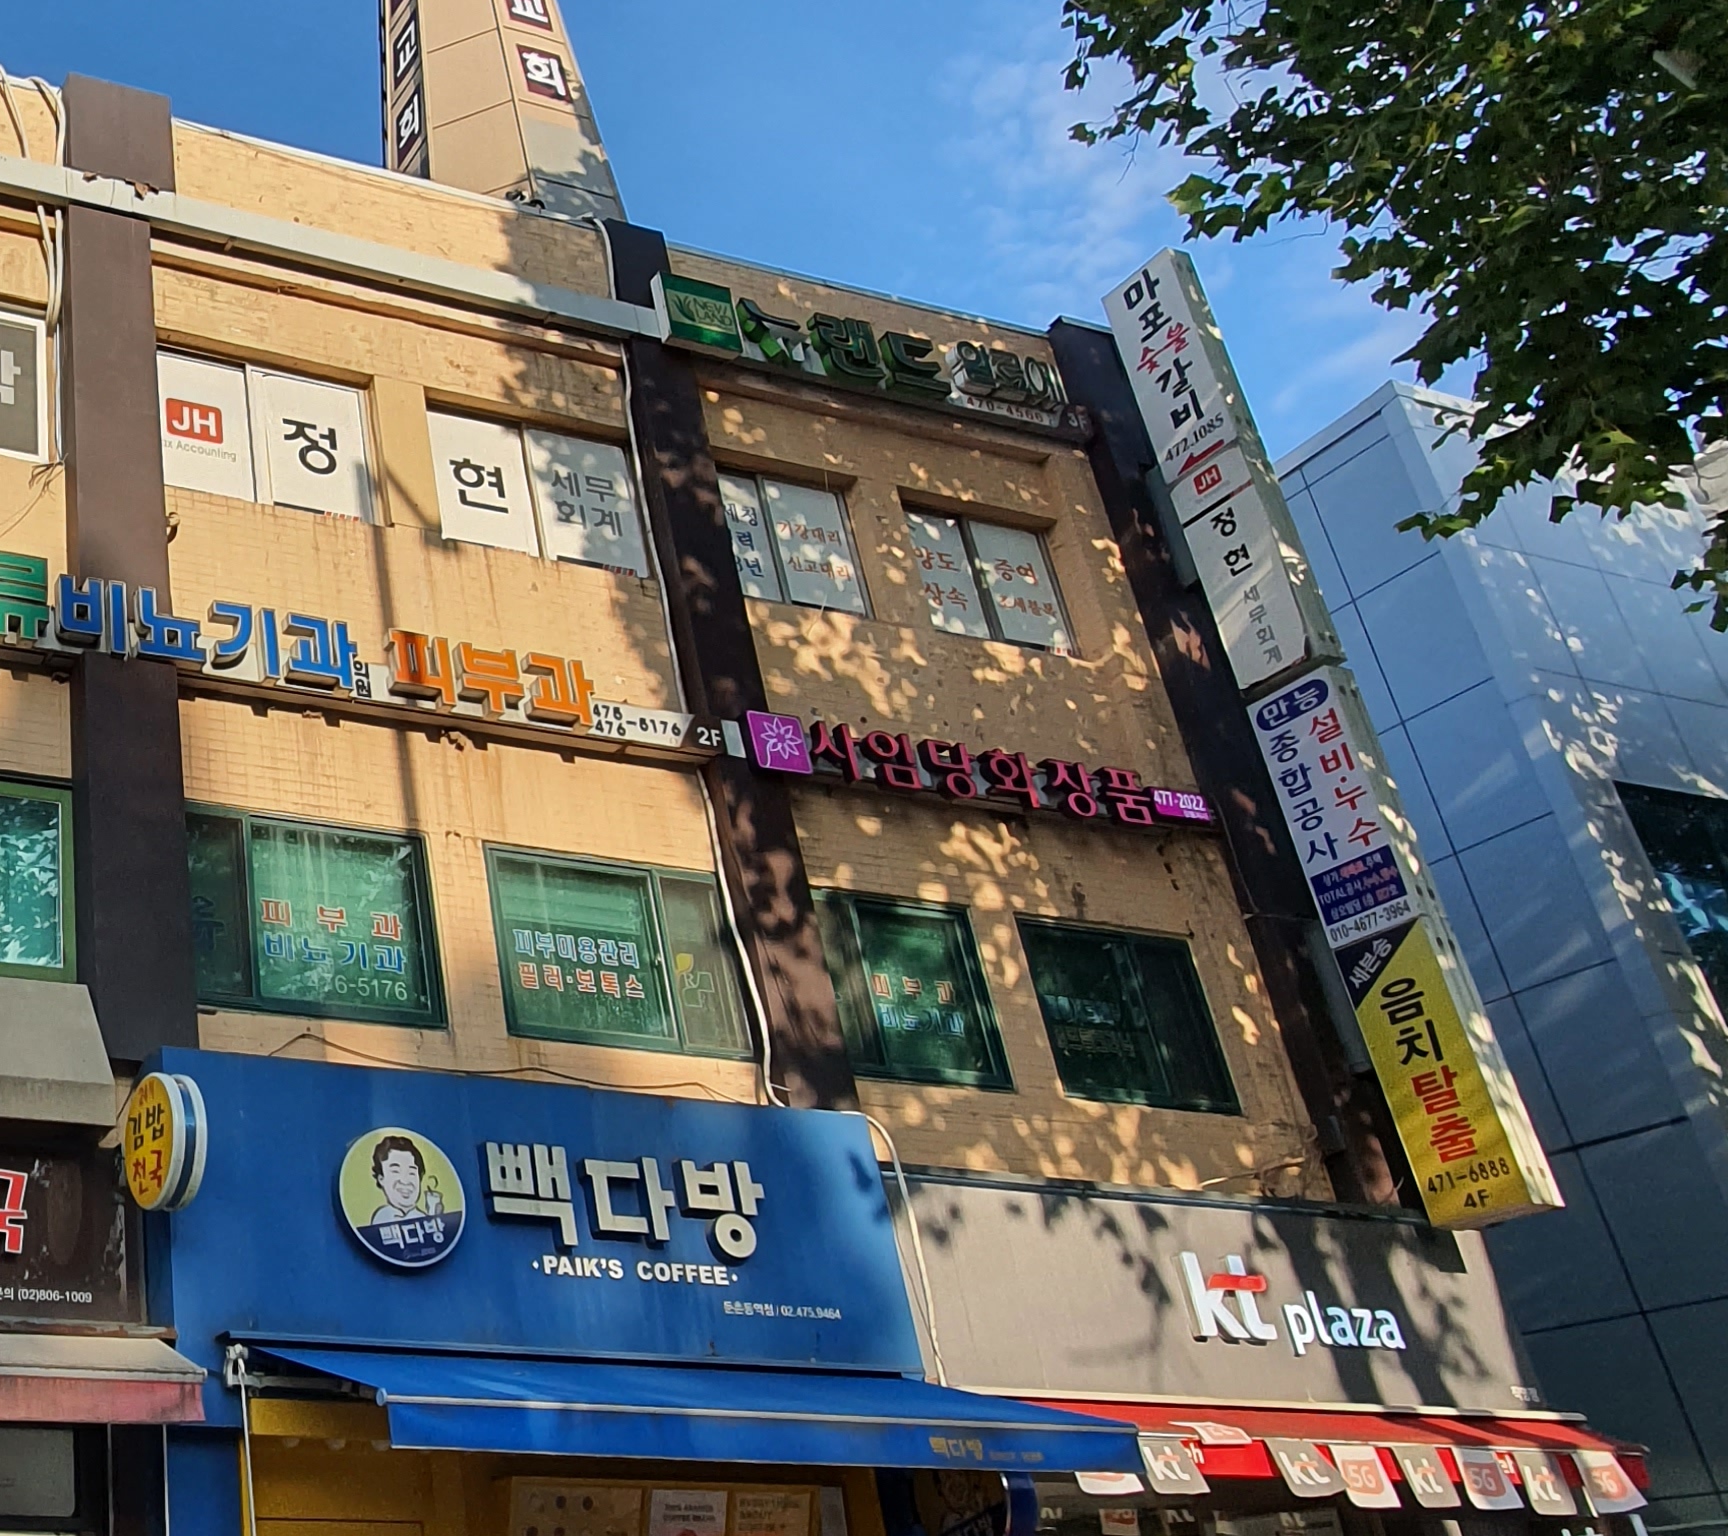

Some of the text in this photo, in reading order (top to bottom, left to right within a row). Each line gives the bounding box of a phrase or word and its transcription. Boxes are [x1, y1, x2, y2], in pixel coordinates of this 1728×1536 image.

[171, 406, 217, 438] JH
[175, 440, 237, 462] Accounting
[552, 467, 614, 504] 세무
[1198, 467, 1220, 491] JH
[556, 500, 624, 538] 회계
[912, 546, 961, 573] 양도
[923, 581, 969, 612] 상속
[388, 629, 595, 729] 피부과
[1261, 684, 1322, 726] 만능
[696, 726, 722, 748] 2F
[811, 721, 1153, 825] 사임당화장품
[1268, 730, 1339, 865] 종합공사
[262, 931, 407, 976] 비뇨기과
[511, 928, 641, 970] 피부미용관리
[127, 1102, 166, 1152] 김밥
[131, 1149, 163, 1196] 천국
[484, 1141, 765, 1260] 빽다방
[1462, 1189, 1490, 1211] 4F
[379, 1216, 446, 1250] 빽다방
[637, 1261, 730, 1286] COFFEE
[17, 1287, 93, 1303] (02)806-1009
[1179, 1251, 1407, 1356] kt plaza
[1142, 1445, 1192, 1481] kt
[1278, 1451, 1332, 1485] kt
[1348, 1464, 1377, 1489] 5G
[1403, 1457, 1444, 1495] kt
[1471, 1466, 1496, 1492] 5G
[1590, 1470, 1618, 1492] 5G
[1523, 1464, 1562, 1502] kt
